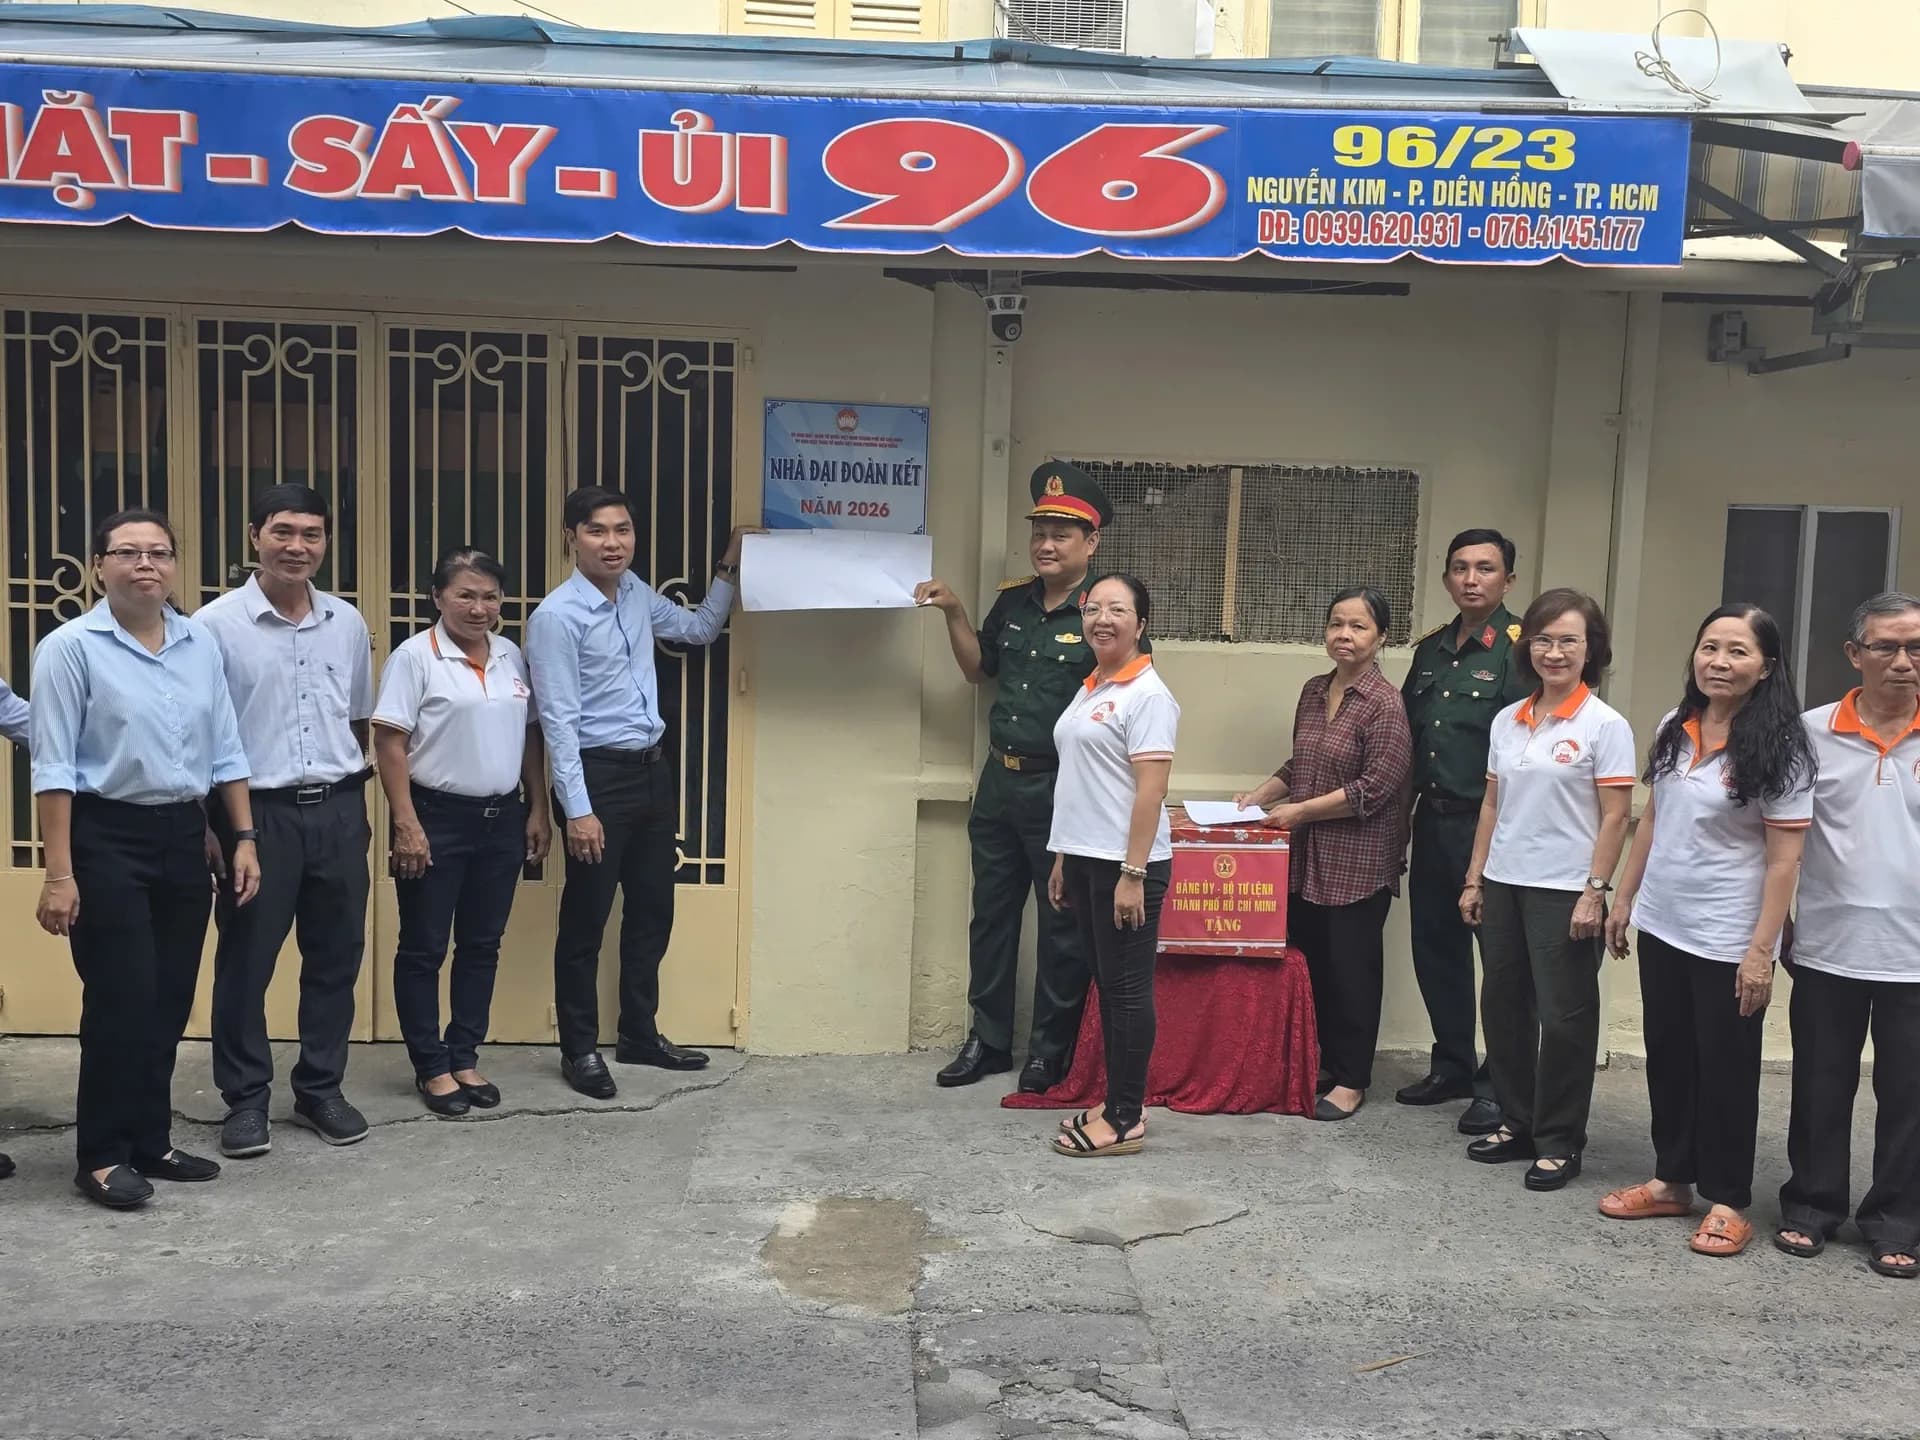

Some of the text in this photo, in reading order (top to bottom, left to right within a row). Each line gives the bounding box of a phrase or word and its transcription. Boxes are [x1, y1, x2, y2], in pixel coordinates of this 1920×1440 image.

[1333, 125, 1576, 171] 96/23
[206, 153, 268, 186] -
[284, 96, 558, 205] SẤY
[555, 166, 617, 198] -
[638, 108, 787, 214] ỦI
[820, 117, 1229, 238] 96
[1247, 168, 1336, 204] NGUYỄN
[1343, 179, 1386, 205] KIM
[1393, 190, 1401, 198] -
[1408, 179, 1425, 206] P.
[1433, 174, 1484, 207] DIÊN
[1491, 172, 1552, 209] HỒNG
[1574, 182, 1602, 210] TP.
[1610, 183, 1659, 212] HCM
[1258, 209, 1645, 251] DĐ: 0939.620.931 - 076.4145.177
[770, 454, 922, 488] NHÀ ĐẠI ĐOÀN KẾT
[800, 495, 890, 518] NĂM 2026
[1251, 880, 1274, 898] LỆNH
[1255, 900, 1277, 913] MINH
[1204, 916, 1242, 935] TẶNG
